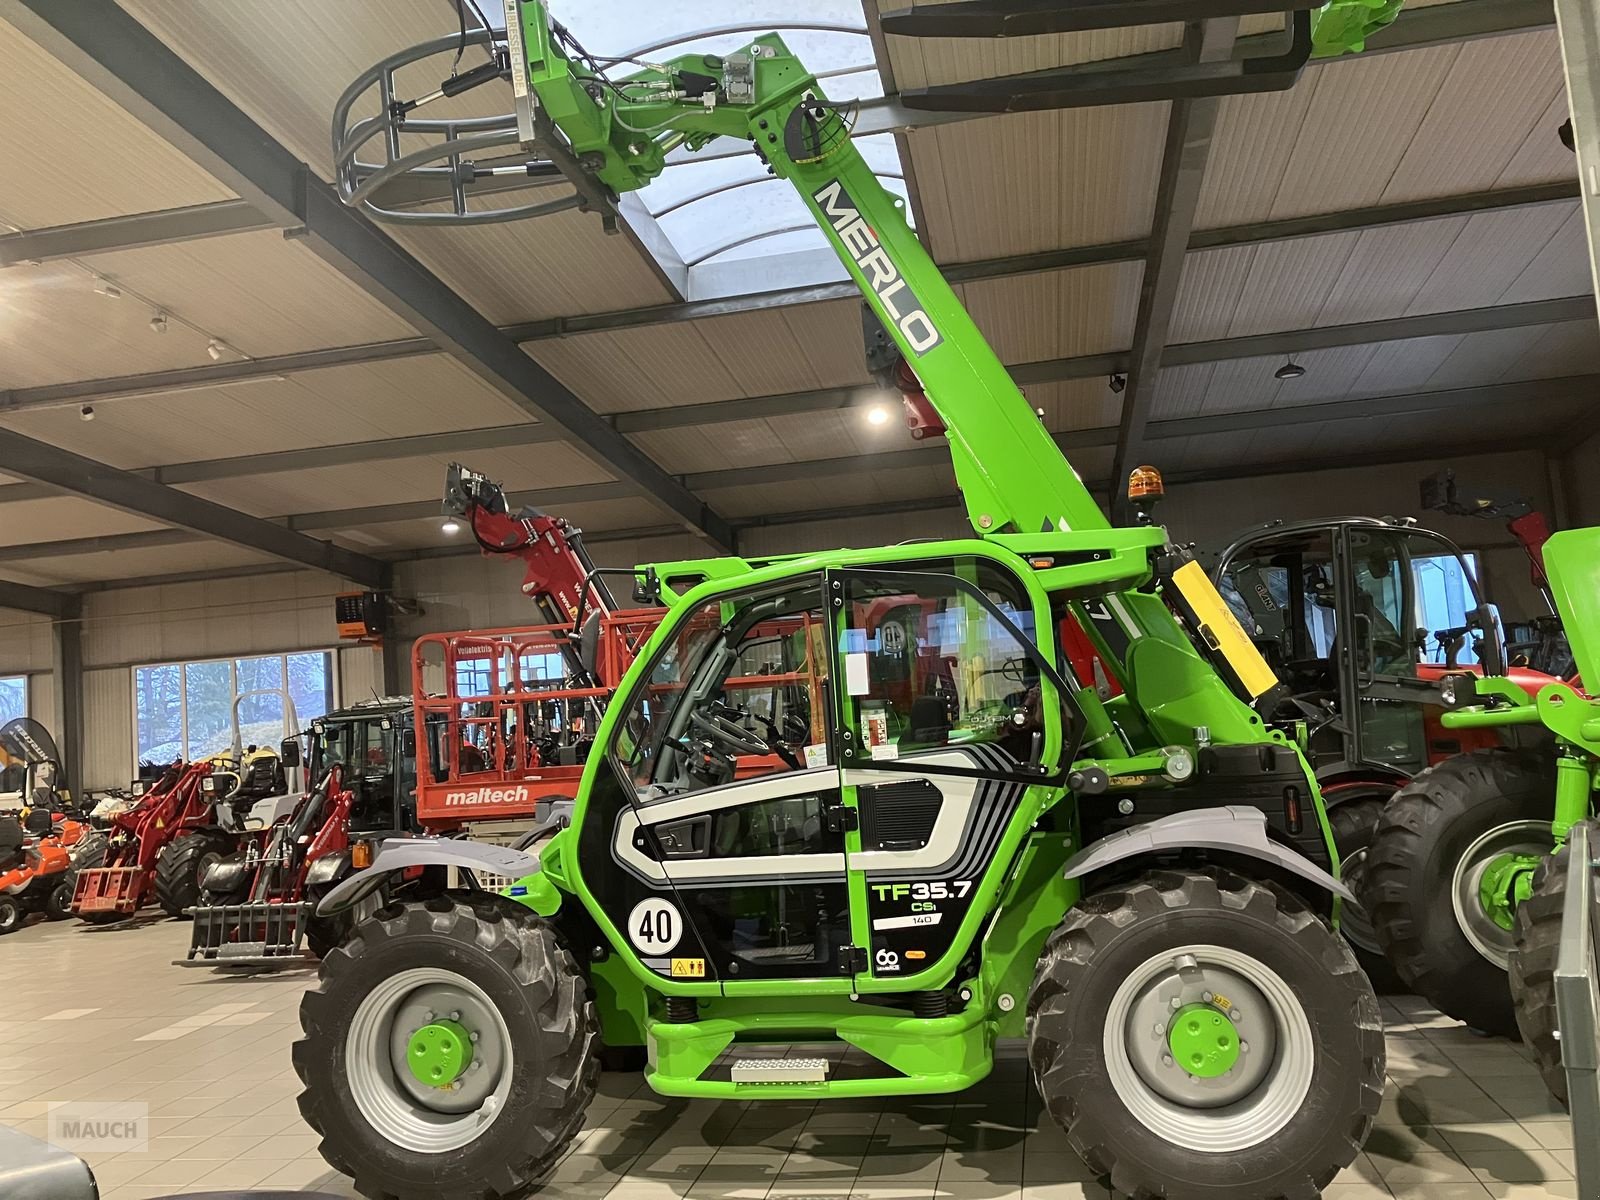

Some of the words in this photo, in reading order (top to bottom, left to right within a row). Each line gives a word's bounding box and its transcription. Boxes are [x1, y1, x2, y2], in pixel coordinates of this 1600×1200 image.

[814, 181, 939, 352] MERLO
[445, 785, 529, 806] maltech
[639, 909, 672, 944] 40
[913, 916, 932, 924] 140
